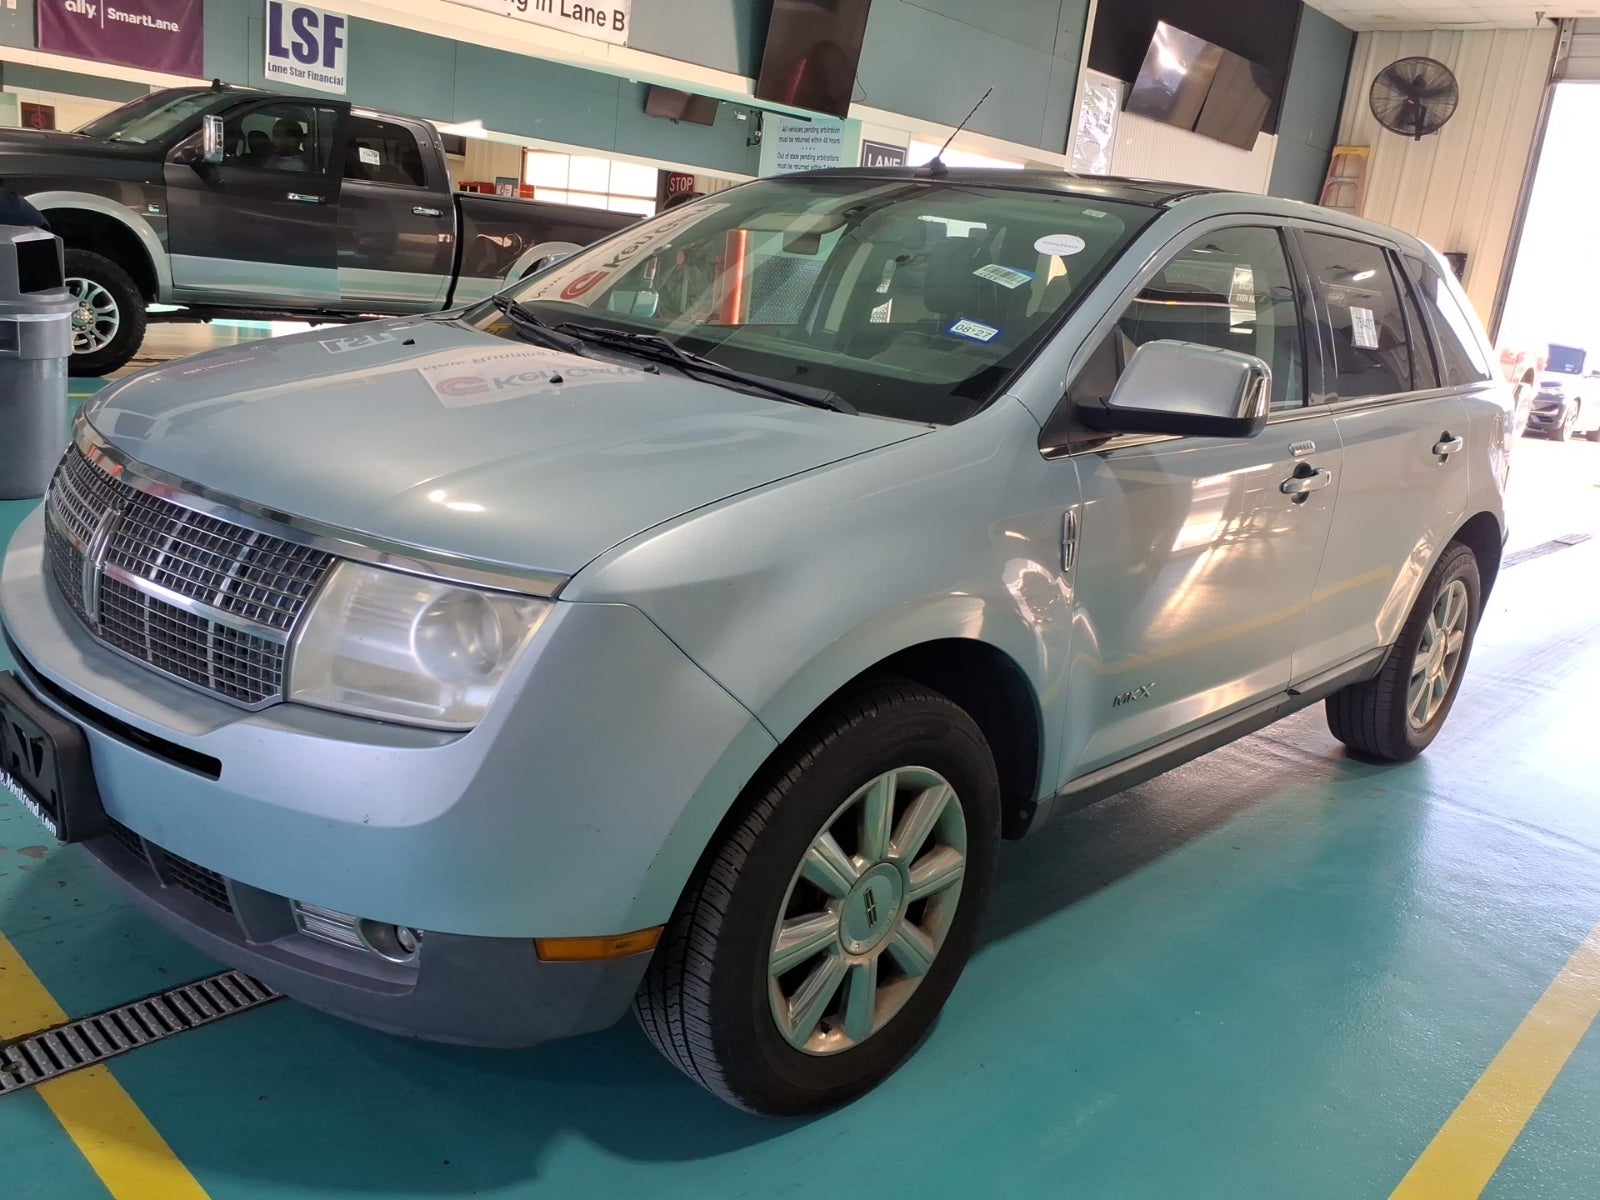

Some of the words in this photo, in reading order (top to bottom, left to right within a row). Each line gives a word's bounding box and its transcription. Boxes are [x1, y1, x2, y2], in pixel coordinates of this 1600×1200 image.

[65, 0, 96, 19] ally
[107, 7, 180, 32] SmartLane
[560, 0, 607, 27] Lane
[612, 9, 625, 32] B
[268, 0, 345, 70] LSF
[267, 62, 288, 75] Lone
[289, 66, 306, 80] Star
[307, 70, 344, 86] Financial
[803, 127, 819, 135] pending
[670, 176, 694, 192] STOP
[955, 324, 971, 333] 08
[974, 329, 992, 338] 27
[1112, 682, 1156, 708] MKX
